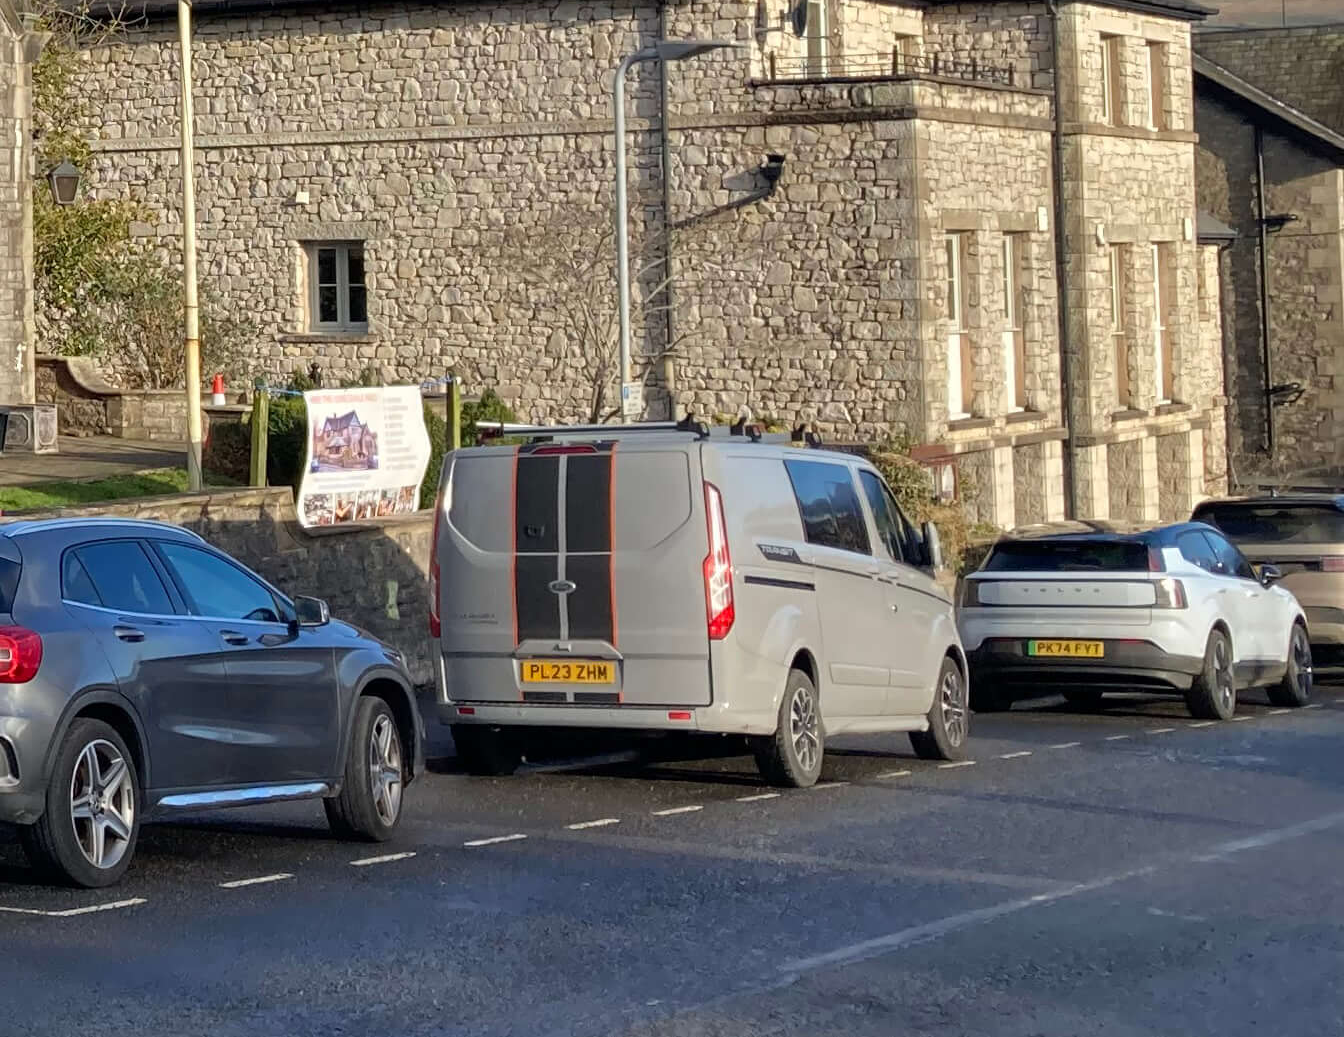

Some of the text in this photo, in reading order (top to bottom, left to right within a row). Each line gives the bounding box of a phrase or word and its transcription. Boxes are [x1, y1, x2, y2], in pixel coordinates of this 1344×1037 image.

[1037, 642, 1071, 653] PK74
[530, 664, 608, 680] PL23 ZHM
